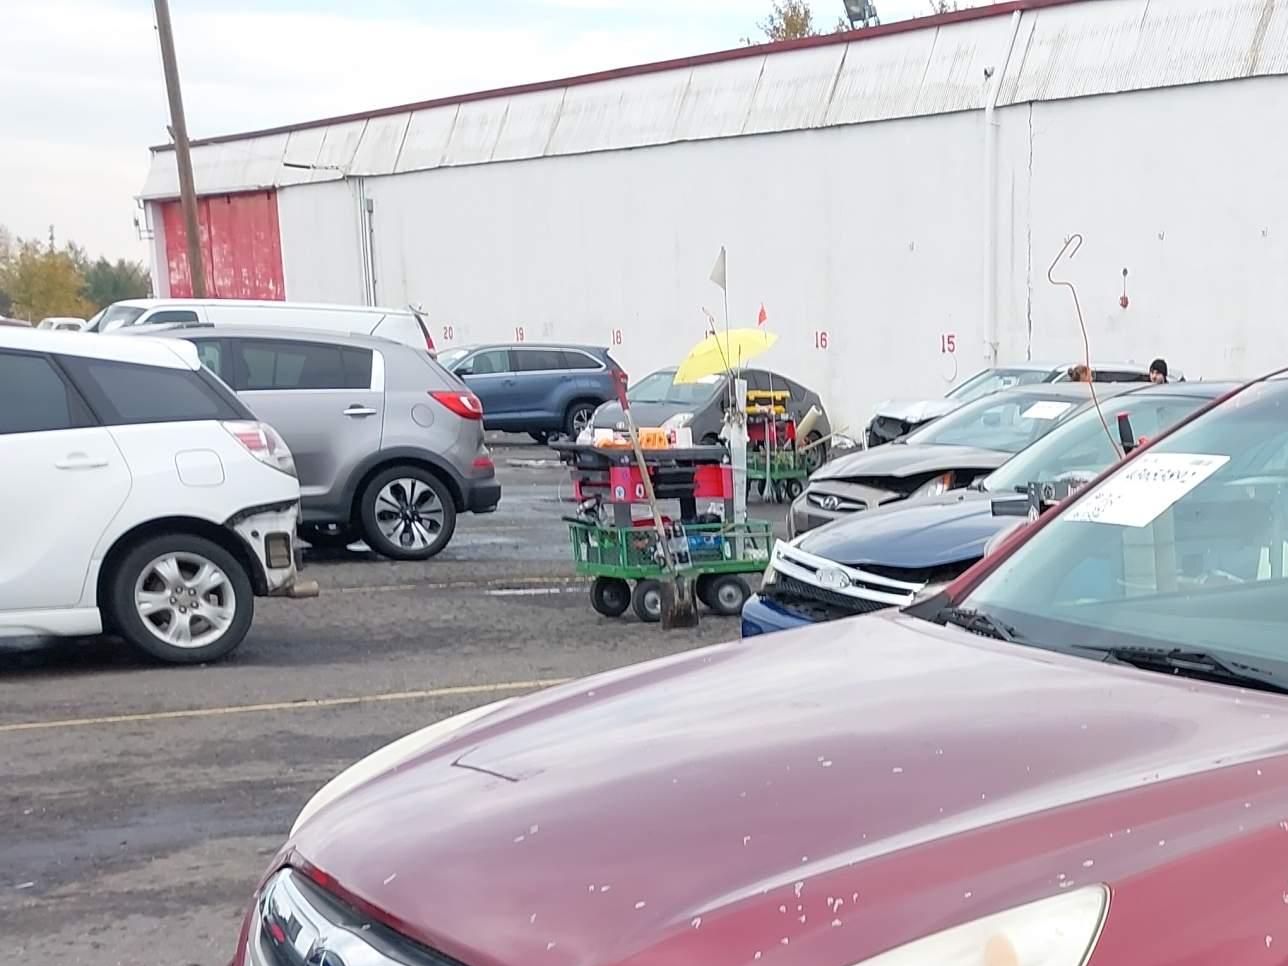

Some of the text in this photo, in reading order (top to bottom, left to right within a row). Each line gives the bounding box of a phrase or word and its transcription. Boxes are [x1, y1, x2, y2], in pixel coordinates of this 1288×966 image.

[443, 326, 453, 340] 20
[515, 327, 525, 341] 19
[612, 330, 622, 345] 18
[815, 331, 828, 349] 16
[941, 334, 956, 353] 15
